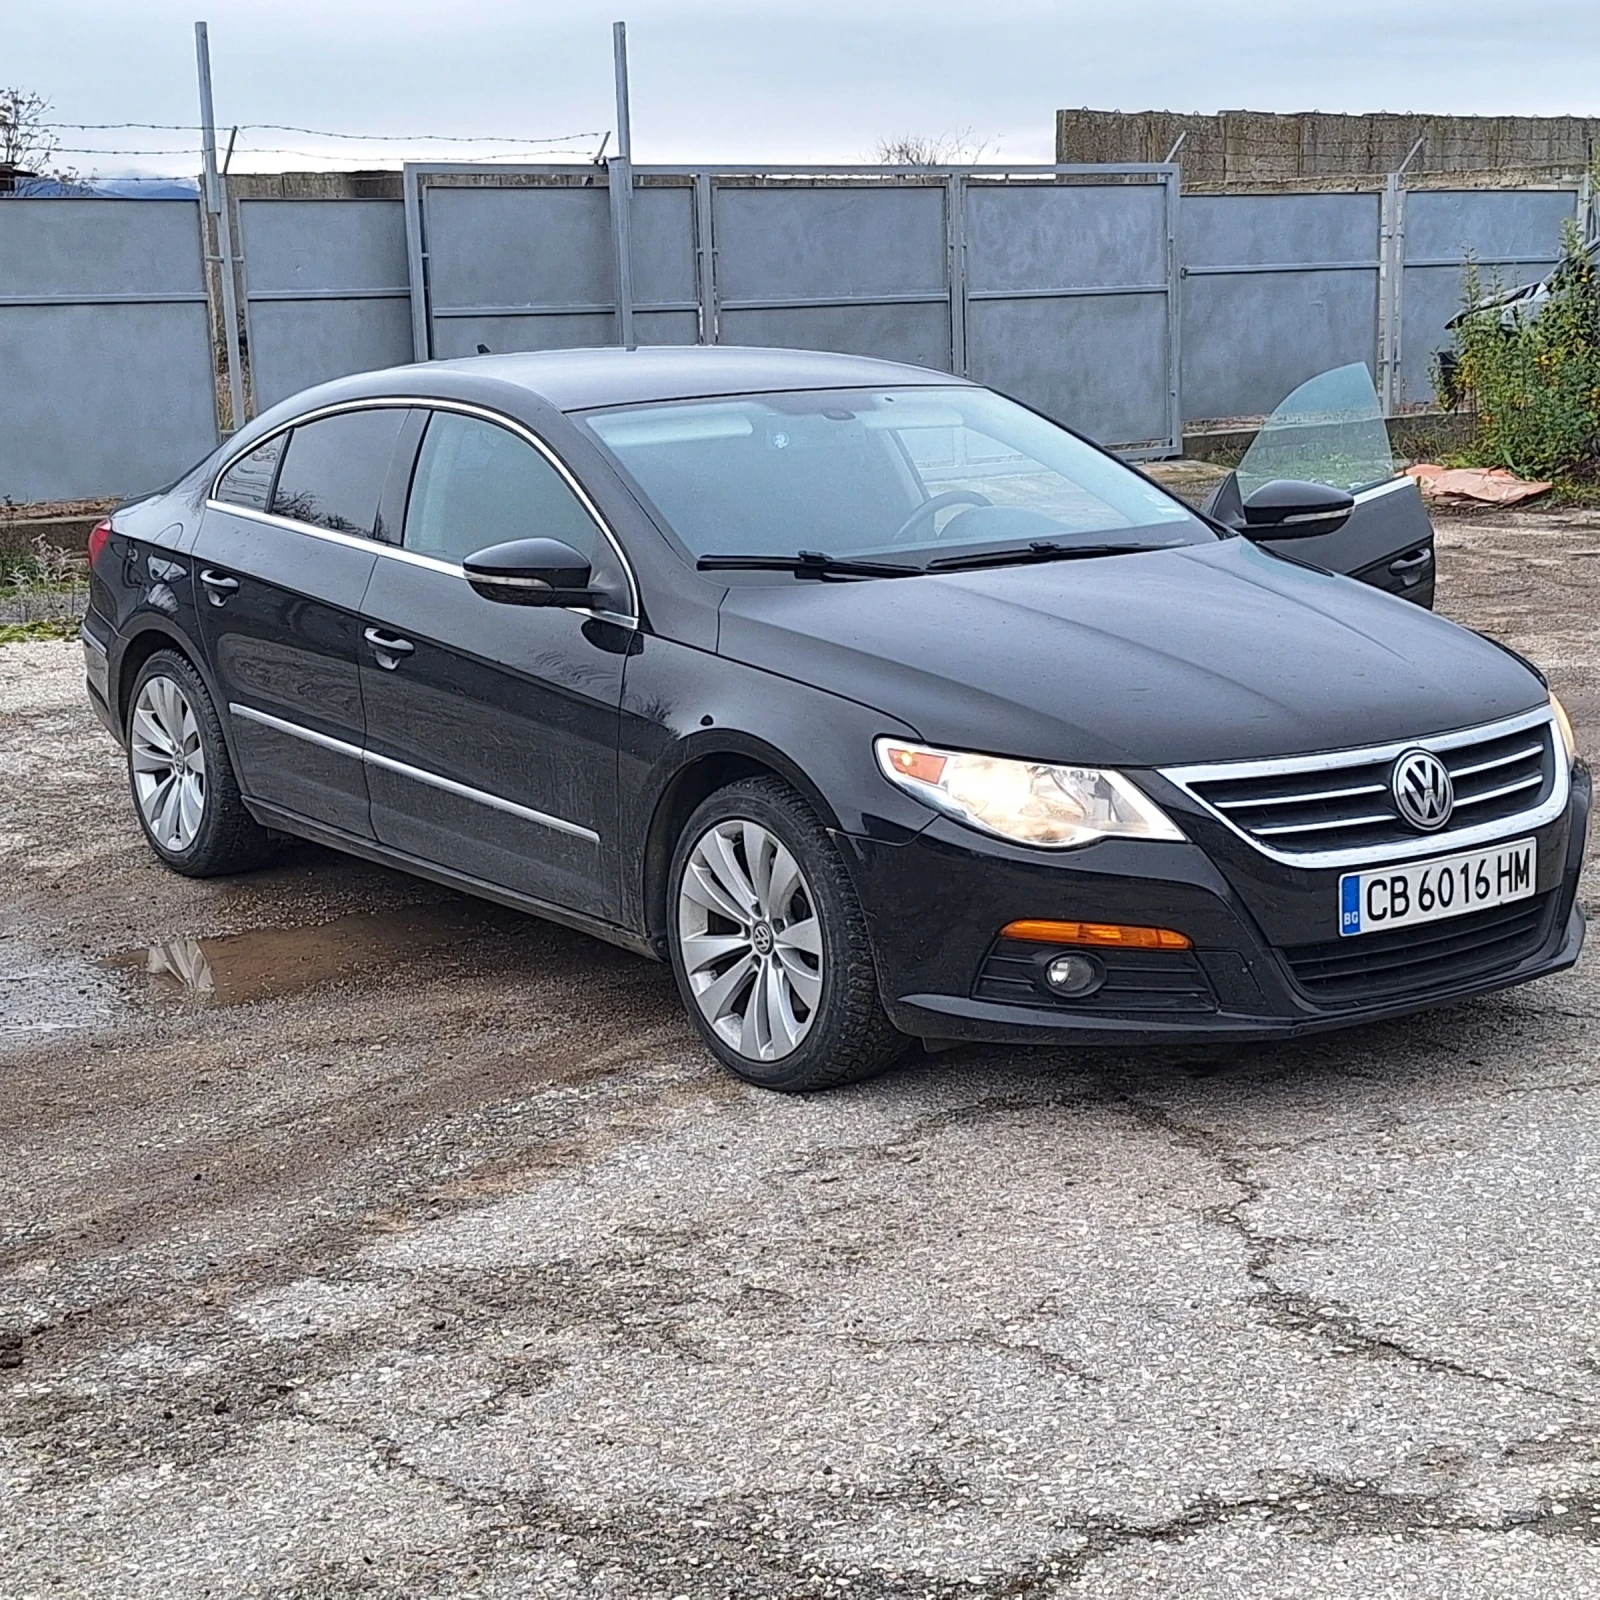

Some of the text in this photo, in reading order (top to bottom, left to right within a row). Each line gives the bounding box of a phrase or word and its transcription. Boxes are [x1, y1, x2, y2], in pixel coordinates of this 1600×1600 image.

[1397, 753, 1450, 826] VW
[1344, 911, 1359, 925] BG
[1366, 848, 1530, 921] CB 6016 HM
